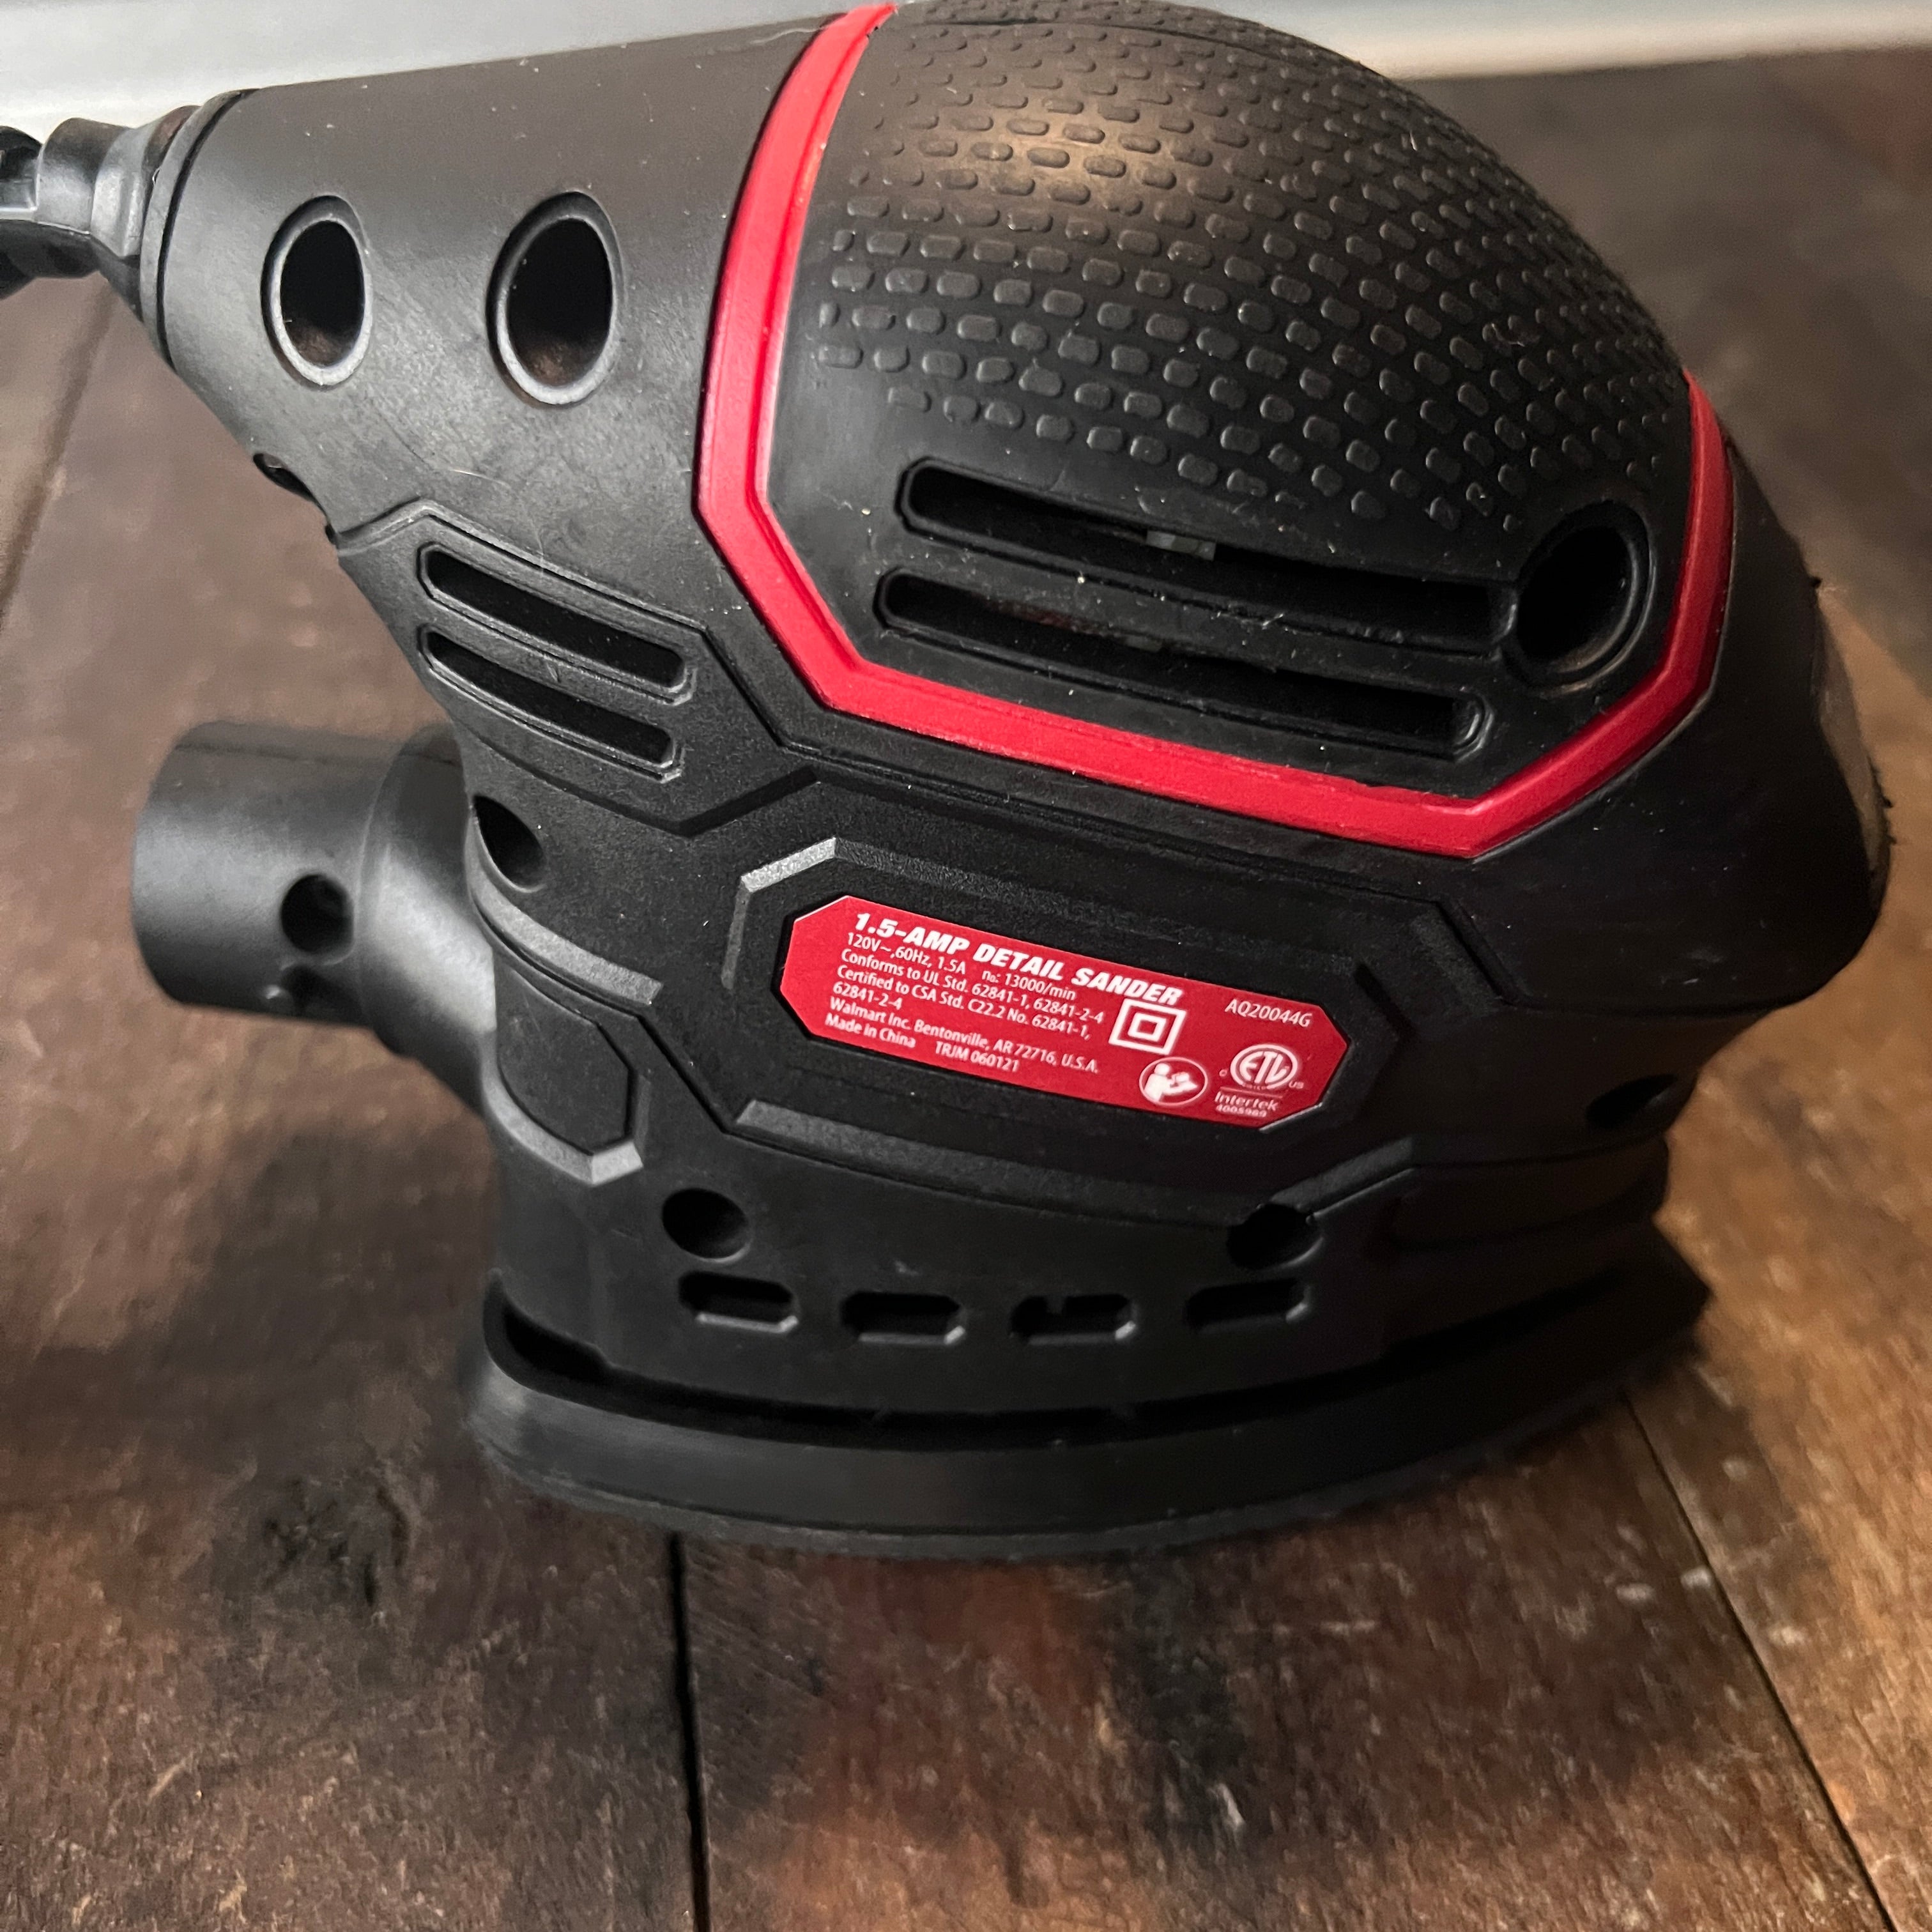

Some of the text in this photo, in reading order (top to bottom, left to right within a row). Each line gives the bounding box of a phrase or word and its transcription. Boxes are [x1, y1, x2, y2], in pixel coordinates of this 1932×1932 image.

[855, 912, 1184, 1006] 1.5-AMP DETAIL SANDER
[938, 956, 966, 975] 1.5A
[1004, 973, 1077, 1000] 13000/min
[832, 981, 903, 1011] 62841-2-4
[837, 964, 1091, 1040] Certified to CSA Std. C22.2 No. 62841-1,
[841, 948, 1104, 1024] Conforms to UL Std. 62841-1, 62841-2-4
[830, 995, 1099, 1074] Walmart Inc. Bentonville, AR 72716, U.S.A.
[1224, 998, 1312, 1029] AQ20044G
[825, 1012, 862, 1034] Made
[878, 1027, 916, 1048] China
[970, 1050, 1020, 1073] 060121
[1239, 1050, 1287, 1084] ETL
[1214, 1091, 1278, 1112] Intertek
